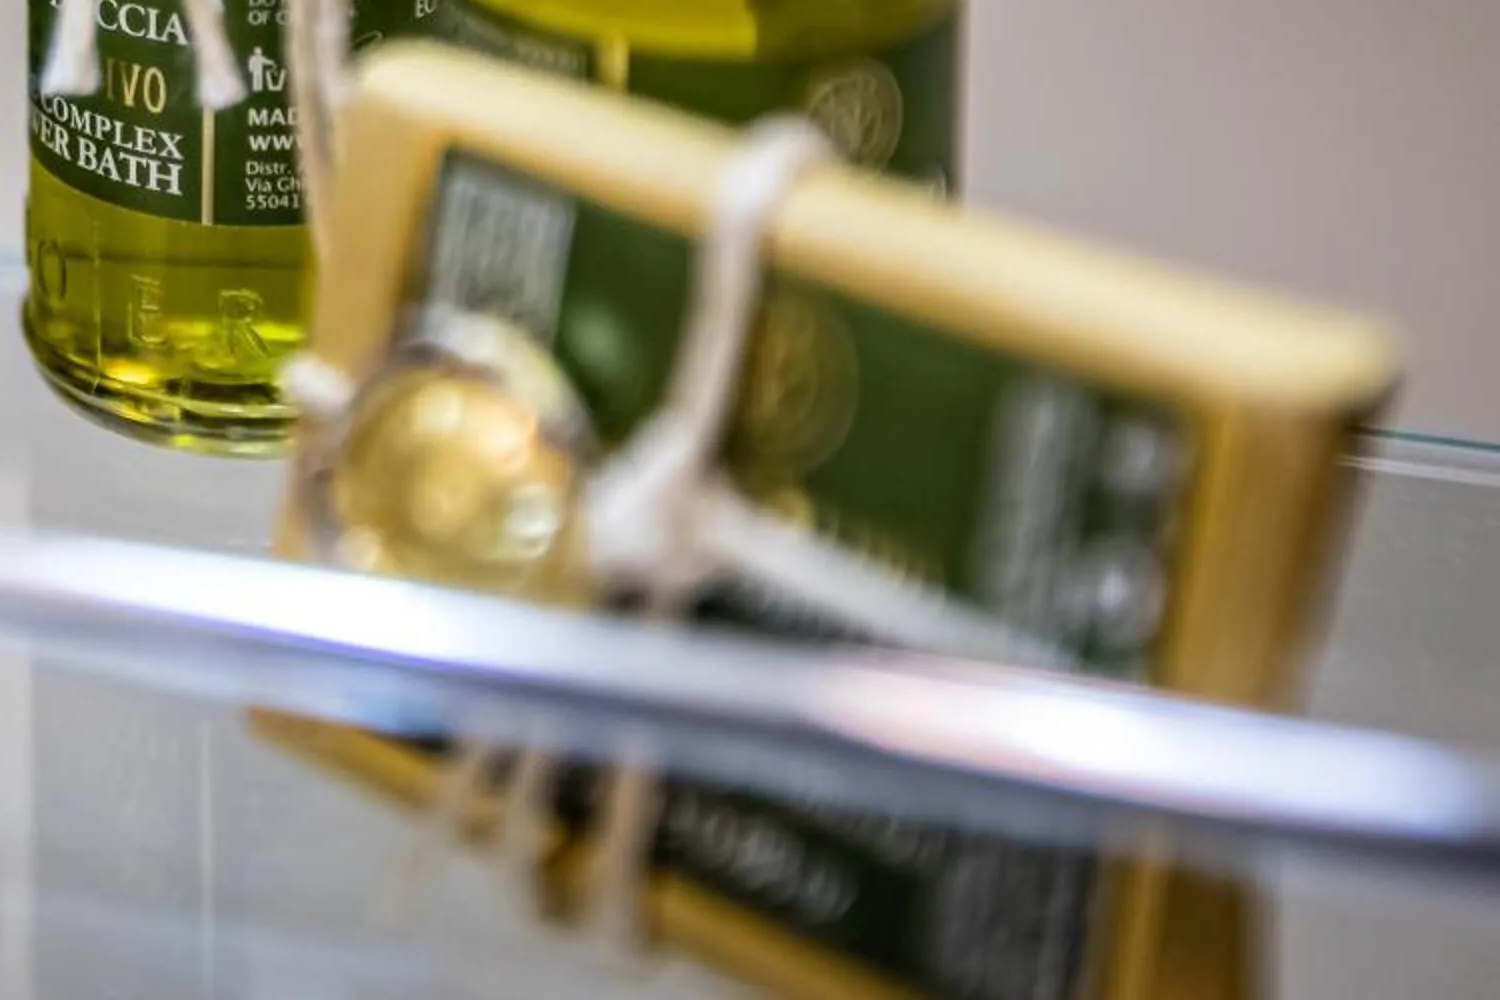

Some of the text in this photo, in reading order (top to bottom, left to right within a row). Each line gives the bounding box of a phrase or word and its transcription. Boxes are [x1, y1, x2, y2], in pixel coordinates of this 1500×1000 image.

[41, 96, 184, 160] COMPLEX
[76, 136, 184, 196] BATH
[246, 160, 292, 175] Distr.
[246, 177, 273, 192] Via
[246, 193, 299, 210] 55041
